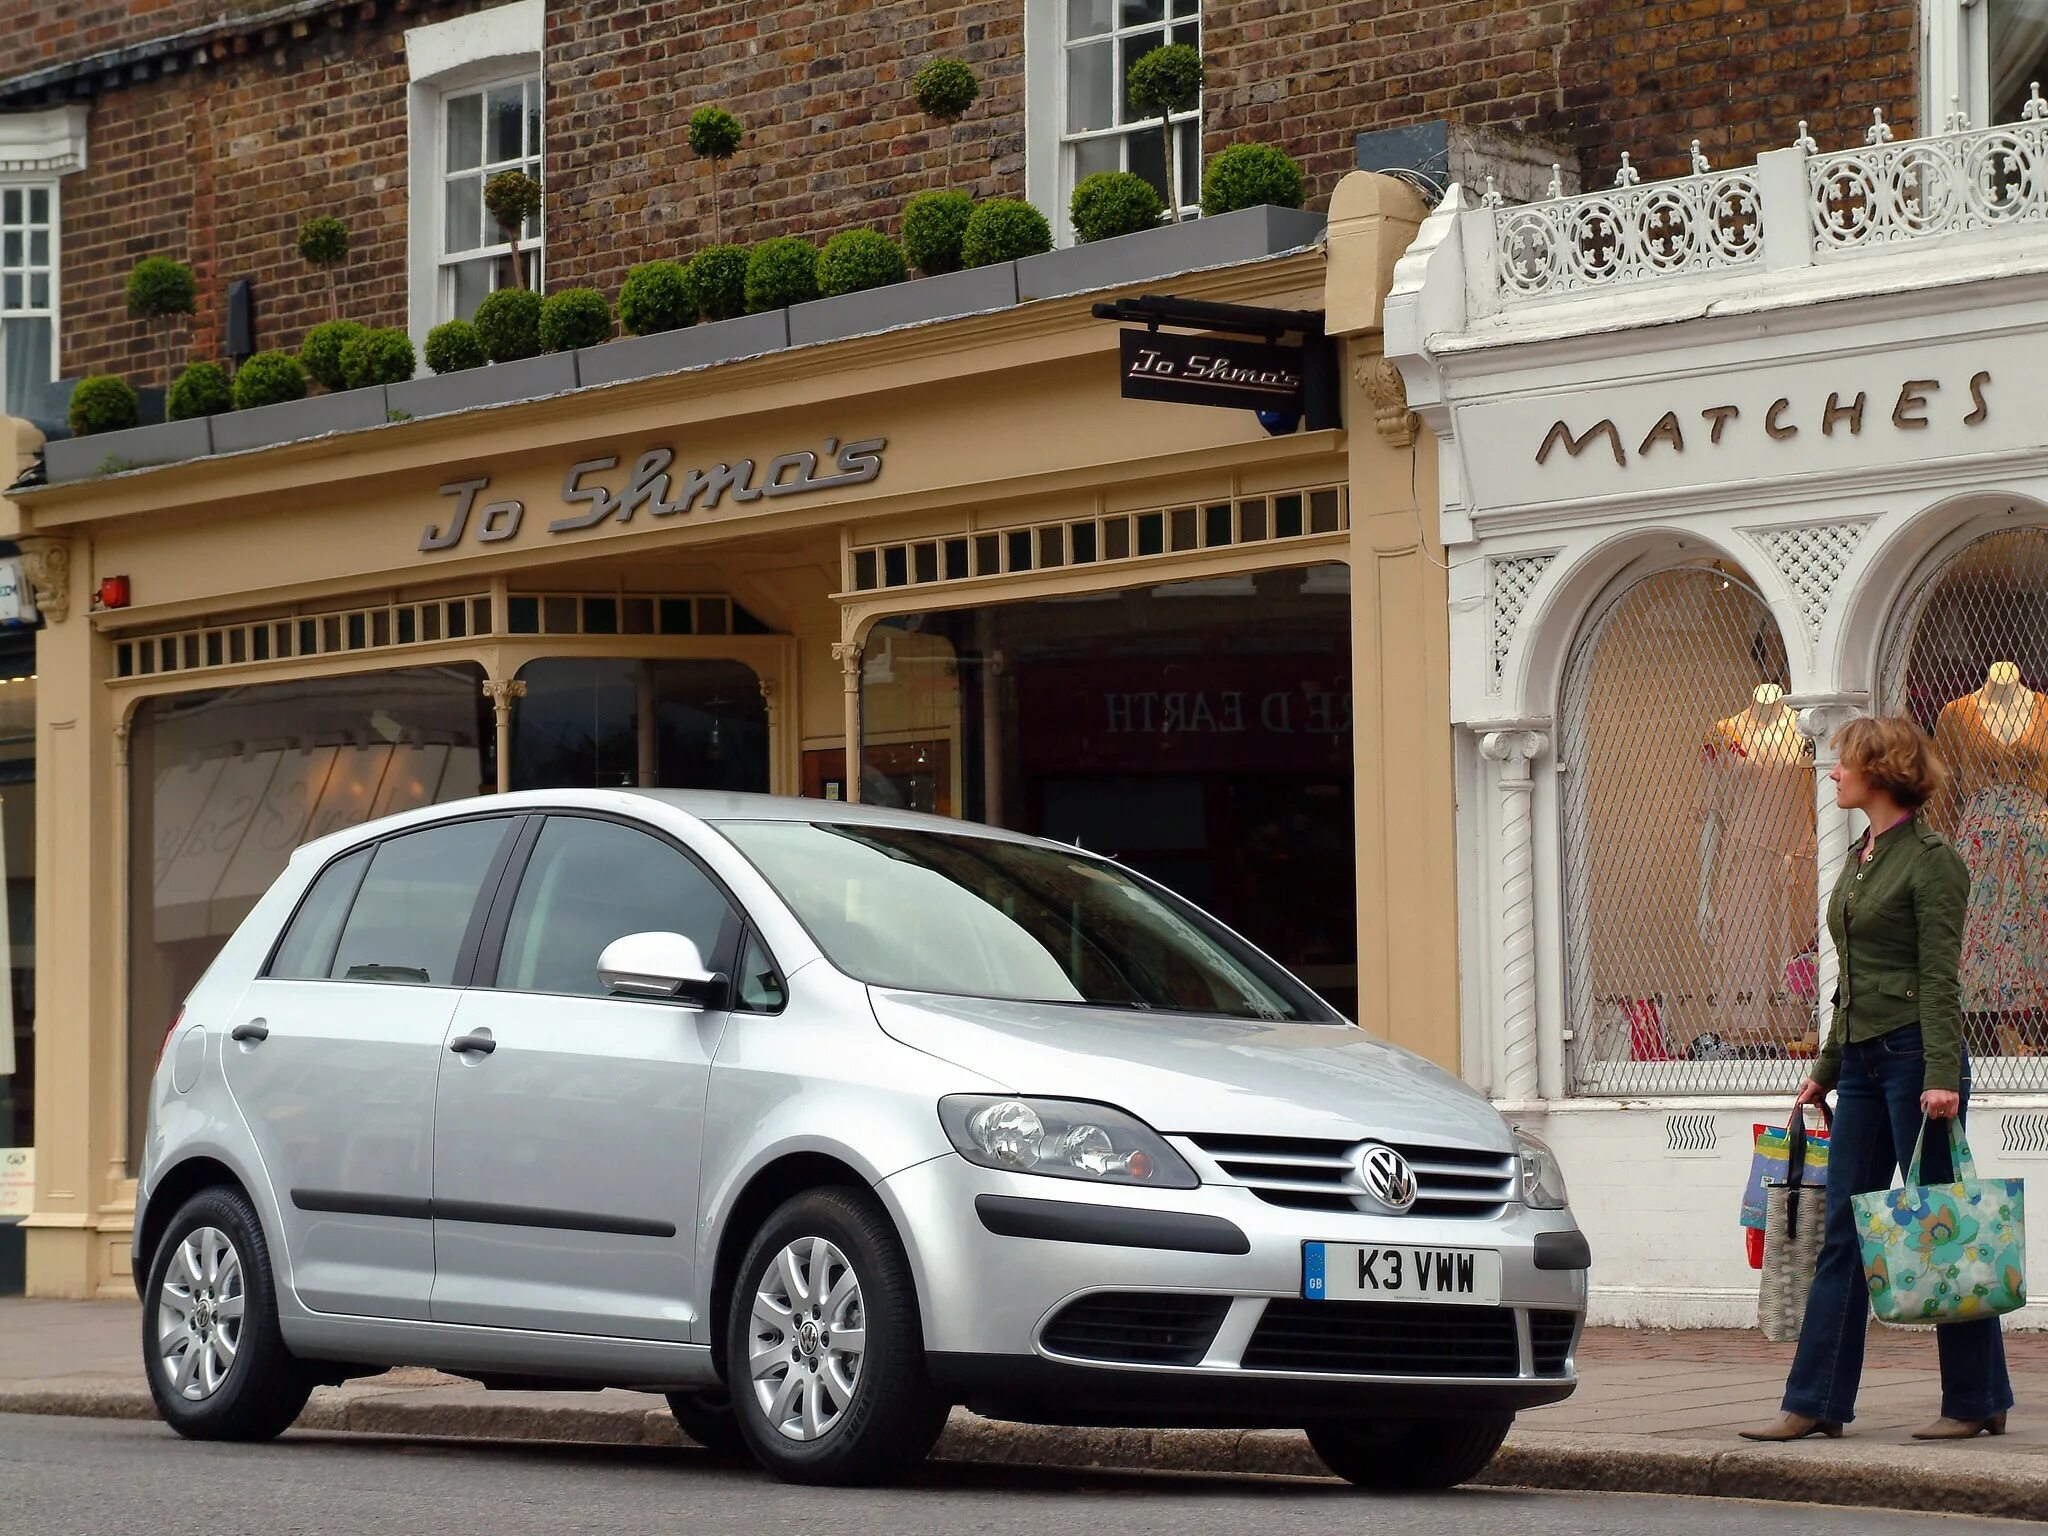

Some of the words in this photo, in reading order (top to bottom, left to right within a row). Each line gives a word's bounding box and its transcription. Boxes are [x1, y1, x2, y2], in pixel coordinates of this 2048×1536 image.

[1130, 349, 1175, 374] Jo
[1182, 354, 1300, 388] Shmo's
[1534, 369, 1991, 468] MATCHES
[418, 475, 524, 552] Jo
[547, 437, 888, 533] Shmo's
[1309, 1278, 1323, 1289] GB
[1357, 1249, 1404, 1290] K3
[1414, 1250, 1475, 1293] VWW
